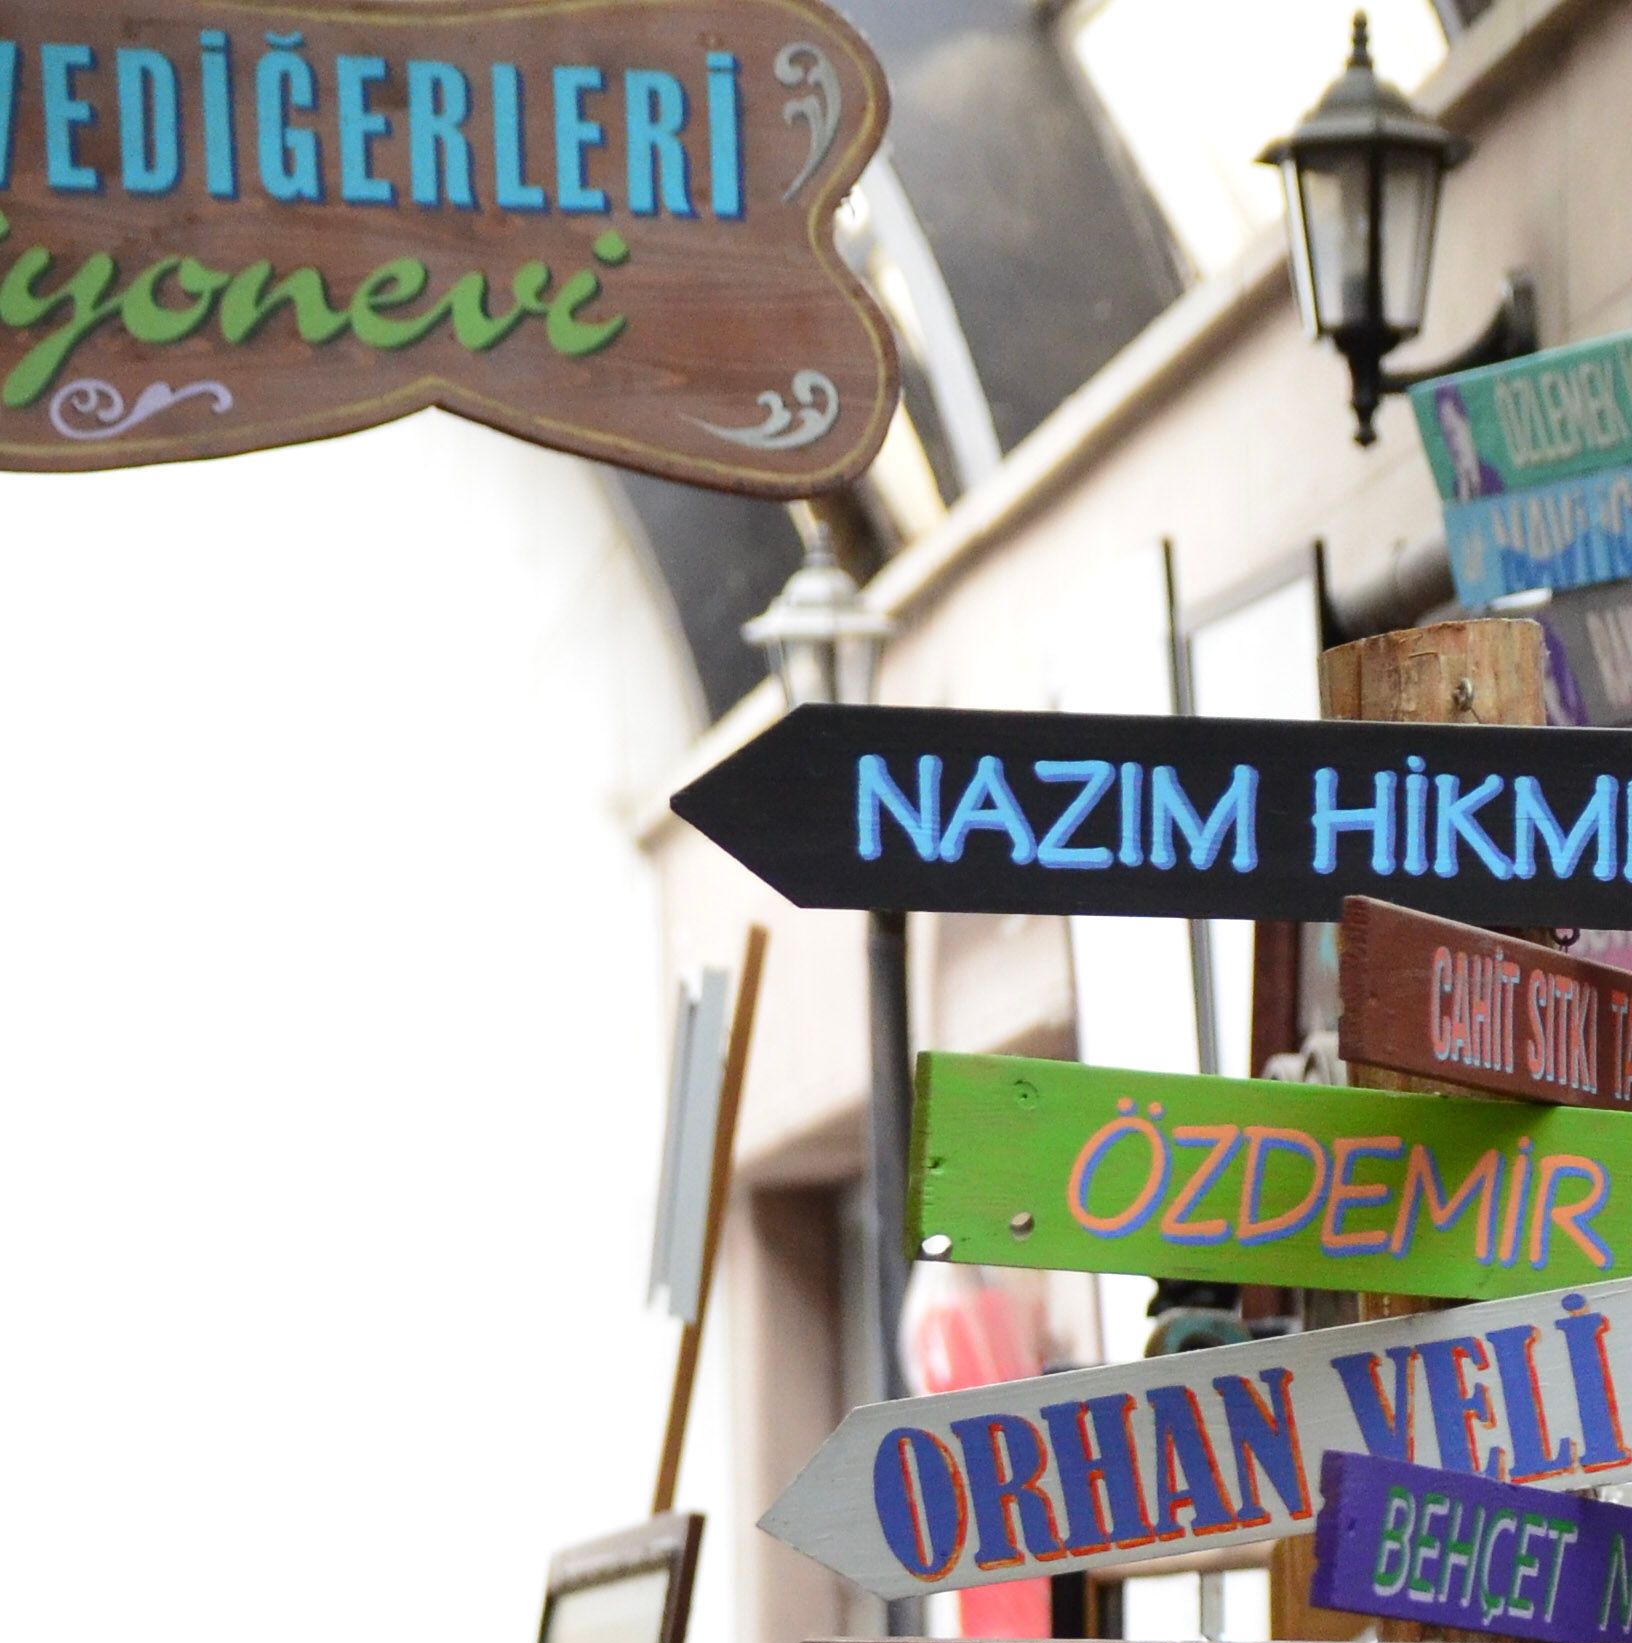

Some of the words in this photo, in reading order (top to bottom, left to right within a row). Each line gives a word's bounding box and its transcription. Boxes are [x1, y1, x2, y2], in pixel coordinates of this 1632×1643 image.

[0, 210, 627, 407] yonevi
[858, 754, 1259, 872] NAZIM
[1430, 943, 1520, 1075] CAHİT
[1526, 959, 1600, 1096] SITKI
[1066, 1097, 1613, 1271] ÖZDEMİR
[872, 1366, 1313, 1583] ORHAN
[1372, 1486, 1579, 1625] BEHÇET
